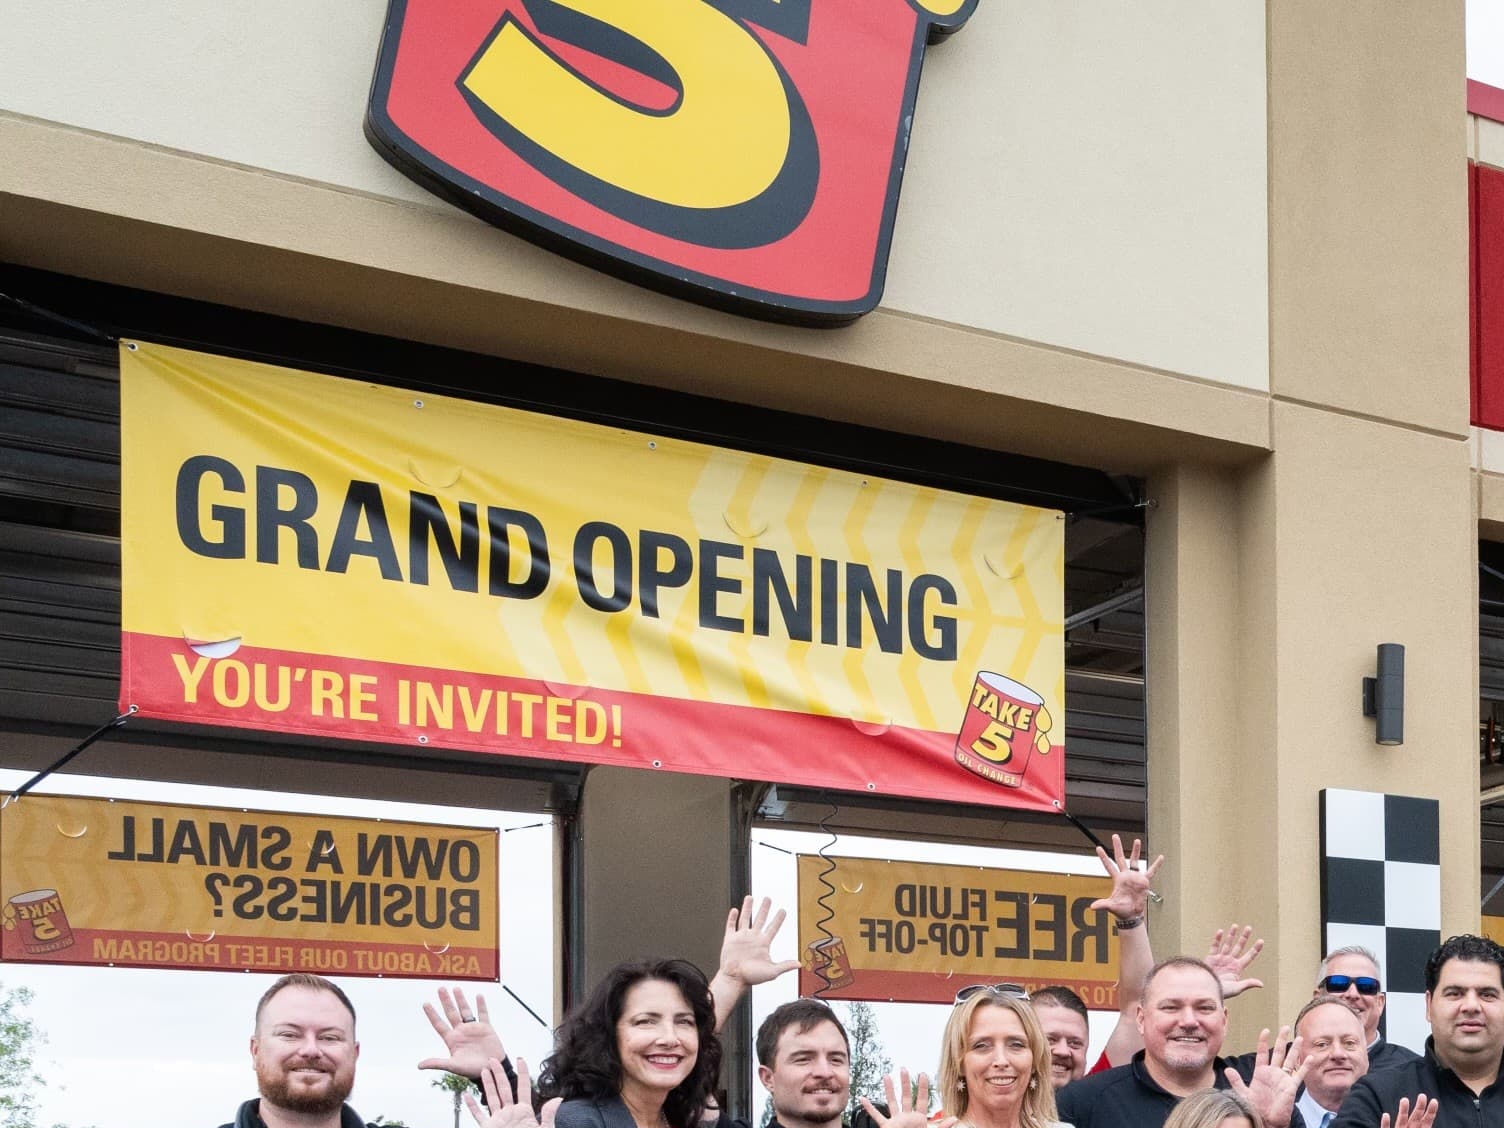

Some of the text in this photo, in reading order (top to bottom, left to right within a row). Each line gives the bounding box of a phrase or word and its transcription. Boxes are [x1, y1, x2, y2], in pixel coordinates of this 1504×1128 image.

[175, 455, 957, 661] GRAND OPENING
[172, 654, 624, 748] YOU'RE INVITED!
[972, 683, 1033, 731] TAKE
[971, 720, 1013, 763] 5
[958, 753, 1016, 785] OIL CHANGE
